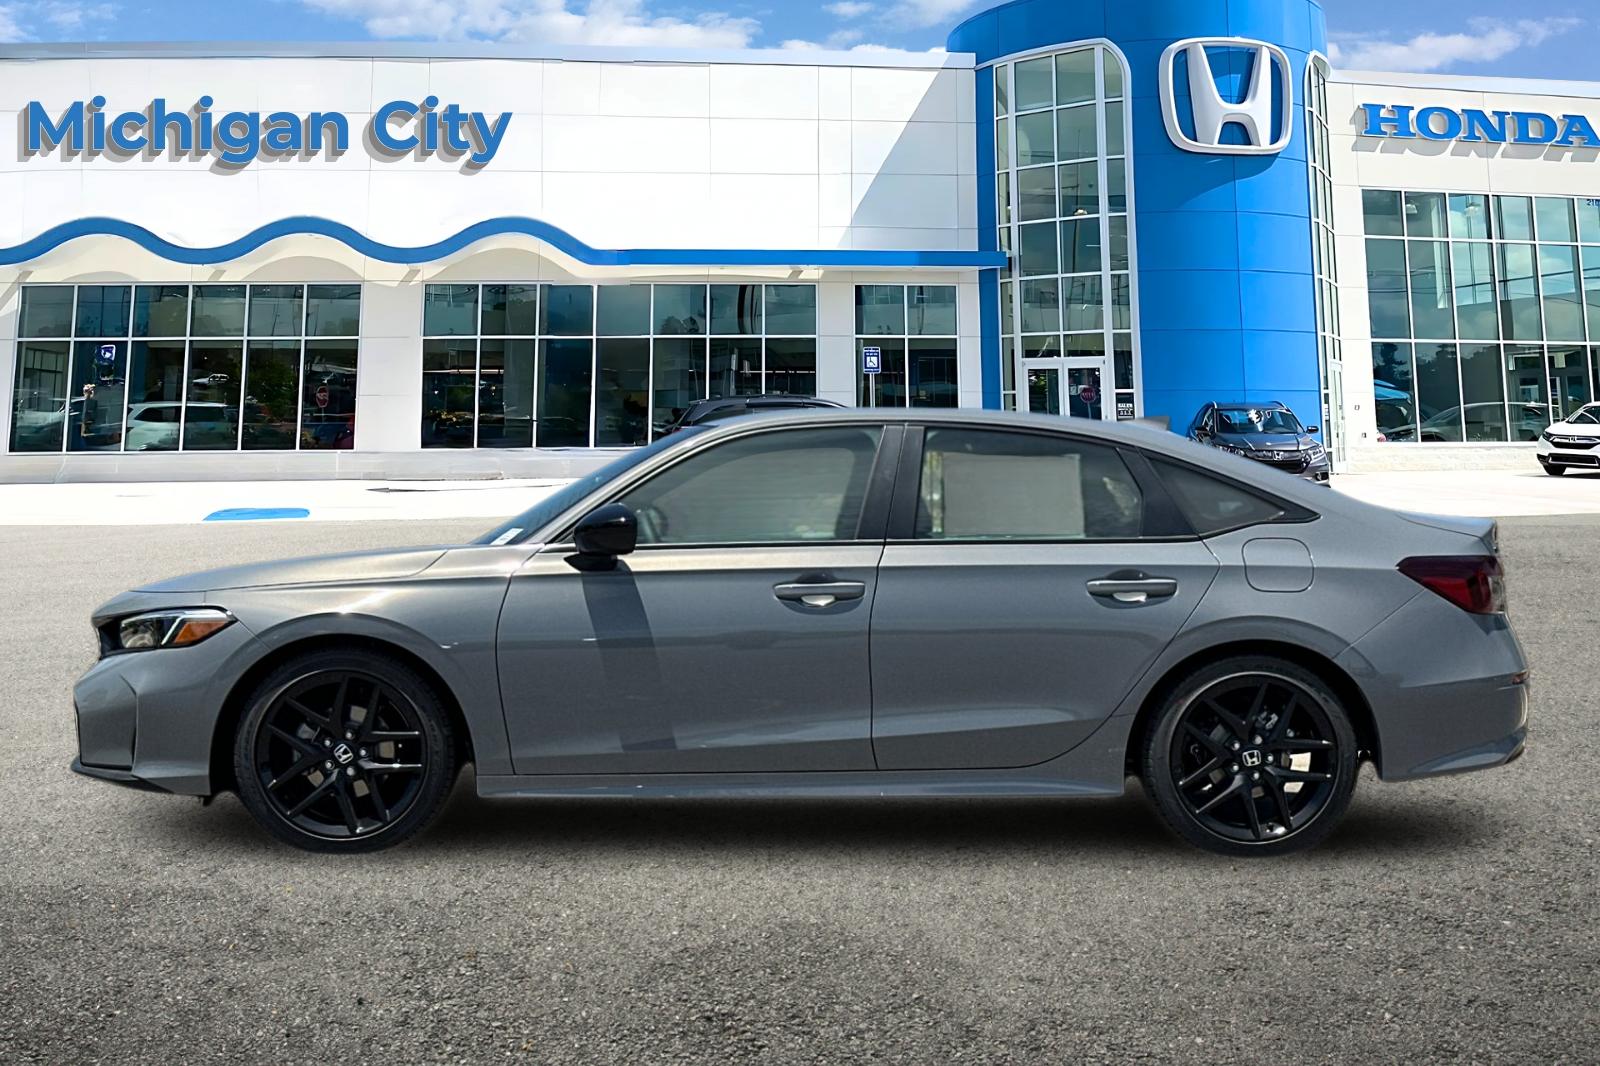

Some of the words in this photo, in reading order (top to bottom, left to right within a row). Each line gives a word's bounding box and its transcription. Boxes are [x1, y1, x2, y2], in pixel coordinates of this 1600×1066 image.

[29, 95, 349, 164] Michigan
[374, 95, 513, 164] City
[1361, 103, 1600, 147] HONDA
